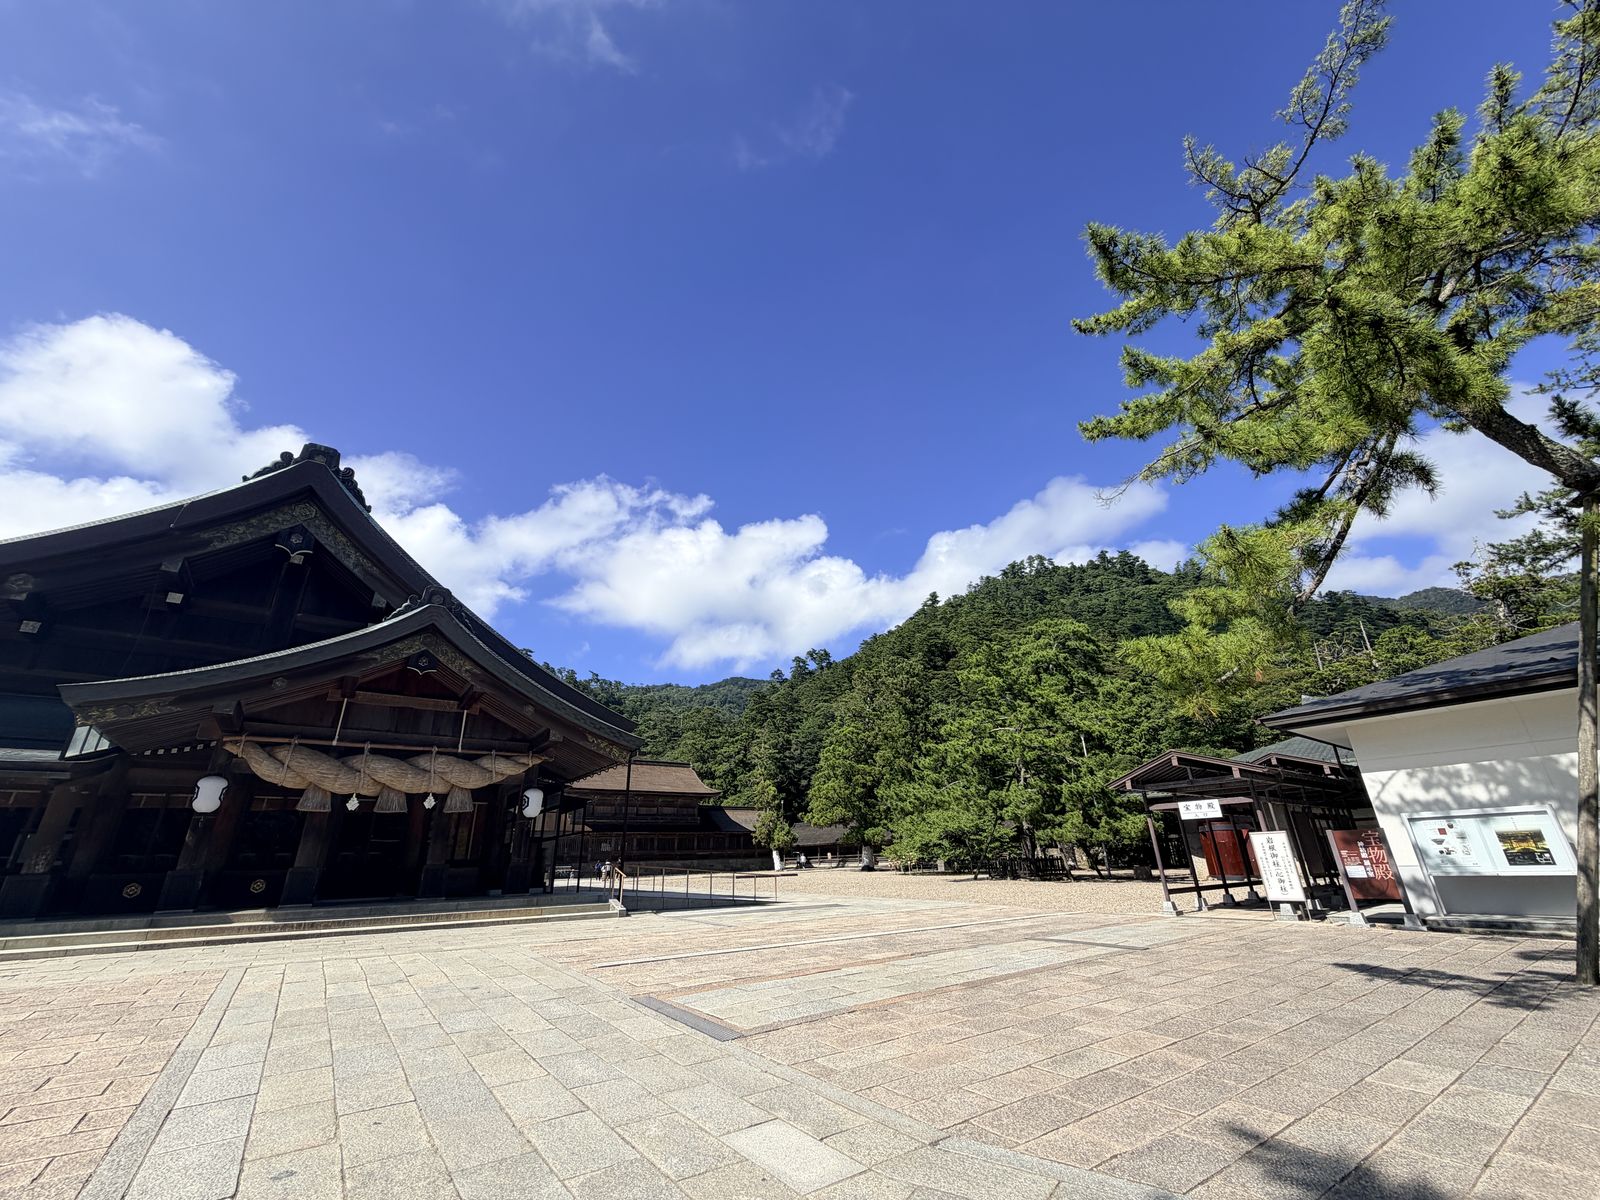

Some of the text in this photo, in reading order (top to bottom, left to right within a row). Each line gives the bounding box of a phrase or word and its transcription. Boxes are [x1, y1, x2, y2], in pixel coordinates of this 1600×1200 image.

[1183, 802, 1216, 811] 宝物殿
[1361, 830, 1395, 880] 宝物殿
